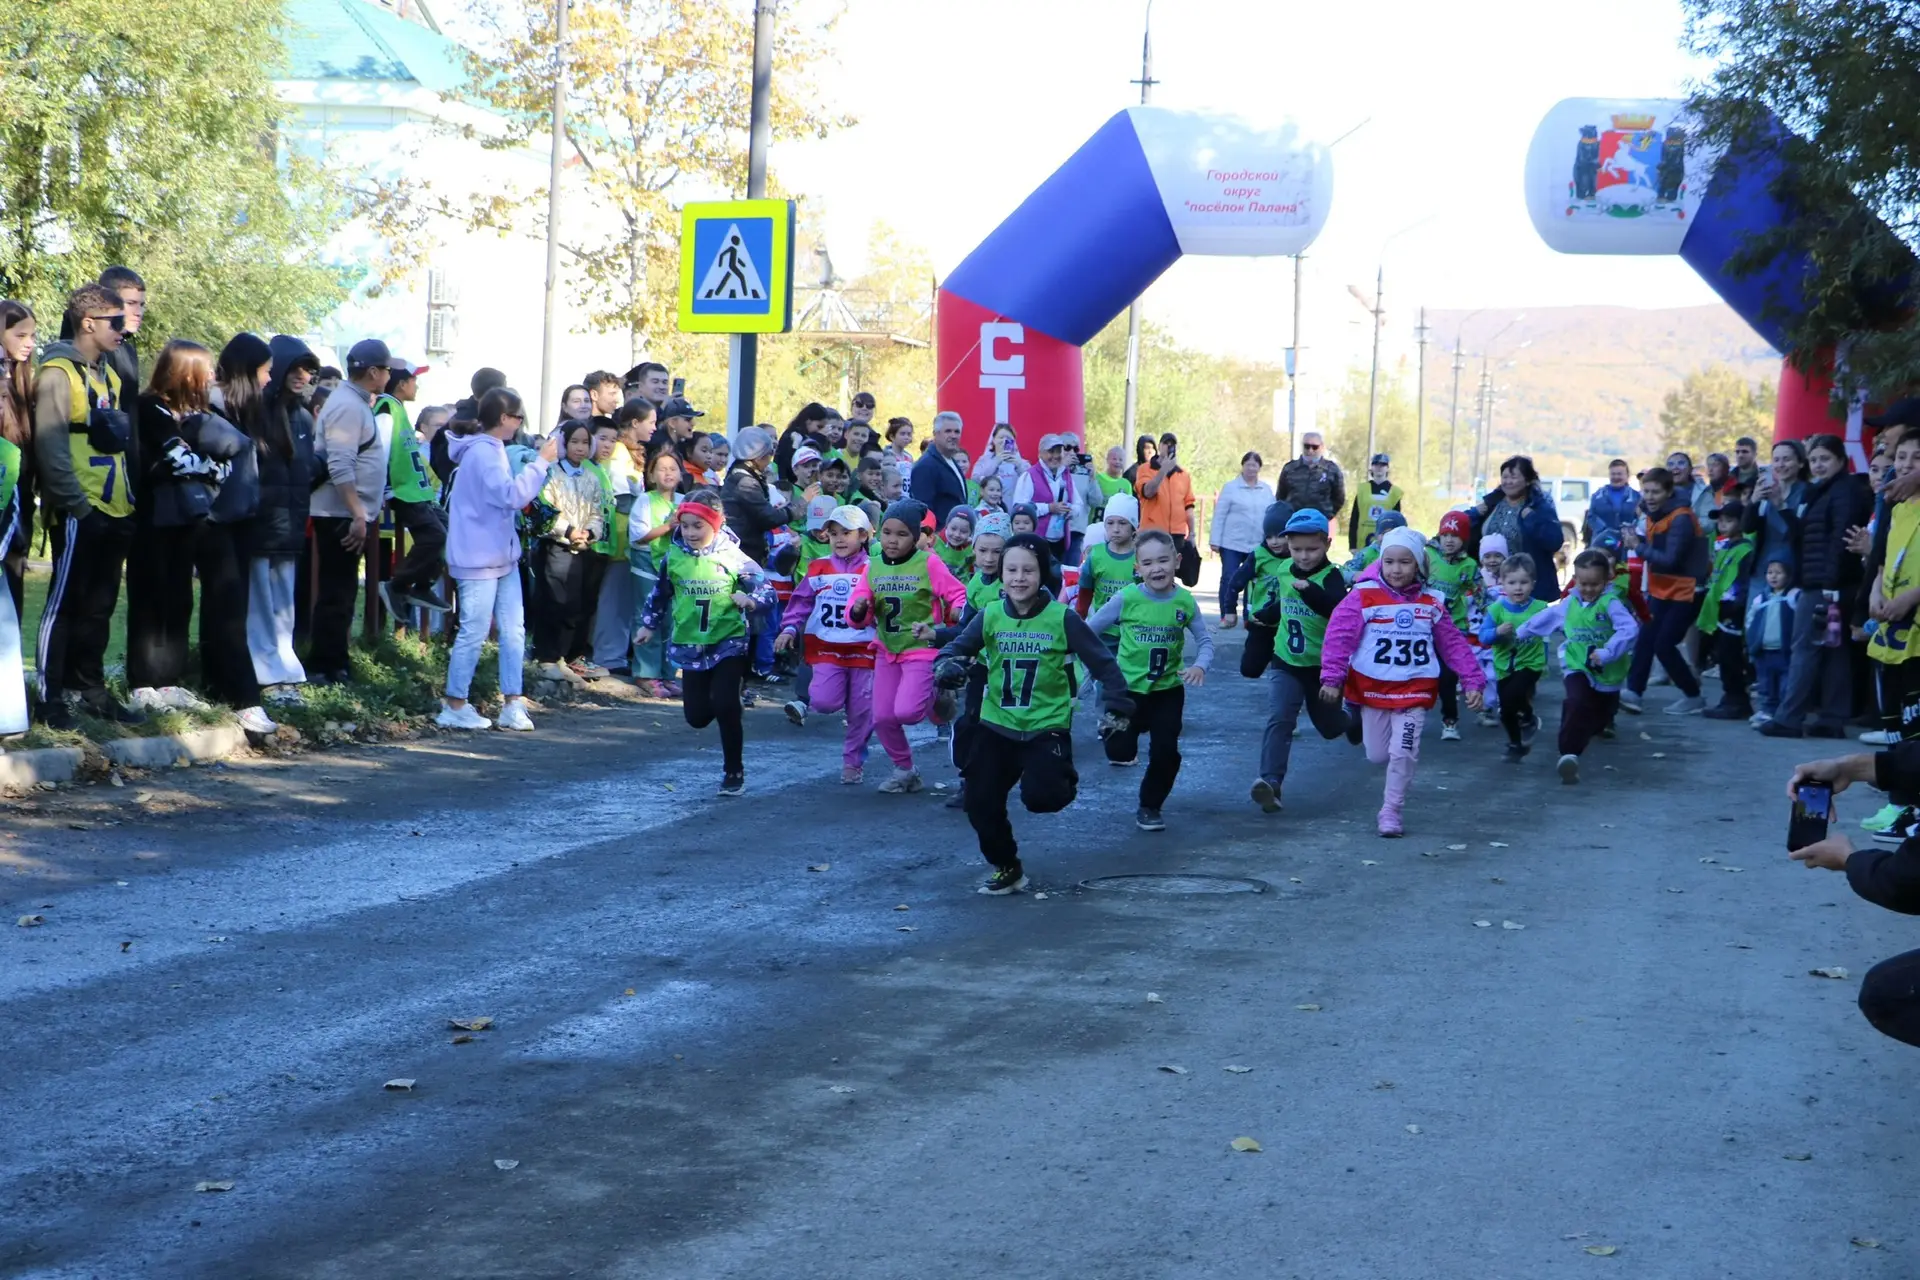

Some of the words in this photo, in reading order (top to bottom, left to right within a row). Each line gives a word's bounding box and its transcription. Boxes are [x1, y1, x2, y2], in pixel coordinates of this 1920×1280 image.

[1207, 169, 1279, 183] Городской
[1223, 186, 1262, 199] округ
[88, 456, 136, 503] 7
[696, 599, 711, 632] 7
[884, 597, 901, 632] 2
[1029, 632, 1053, 641] ШКОЛА
[1287, 619, 1306, 653] 8
[1374, 638, 1430, 666] 239
[1147, 648, 1168, 680] 9
[1001, 659, 1039, 707] 17
[1401, 722, 1416, 751] SPORT
